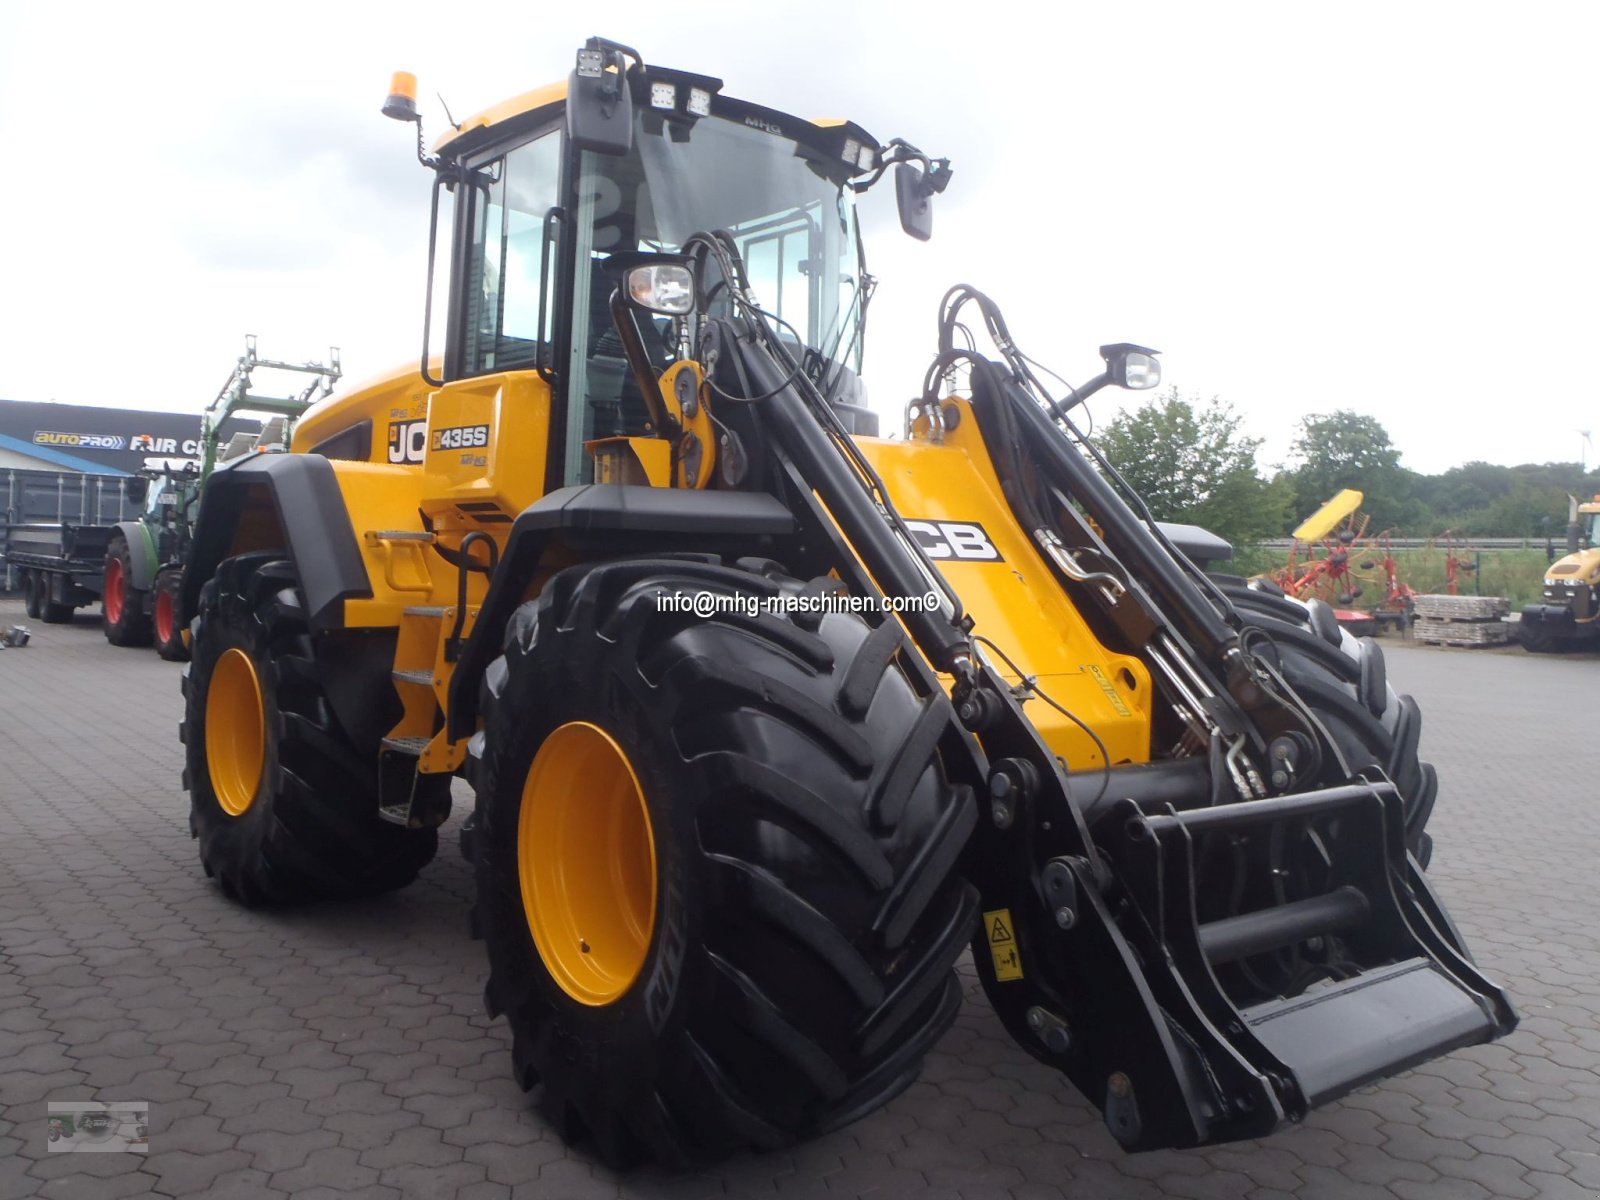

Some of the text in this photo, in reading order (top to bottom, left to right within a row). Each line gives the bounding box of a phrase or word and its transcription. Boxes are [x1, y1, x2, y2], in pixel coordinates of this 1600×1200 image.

[130, 436, 177, 453] FAIR
[389, 422, 426, 463] JC
[441, 426, 487, 448] 435S
[903, 521, 998, 559] CB
